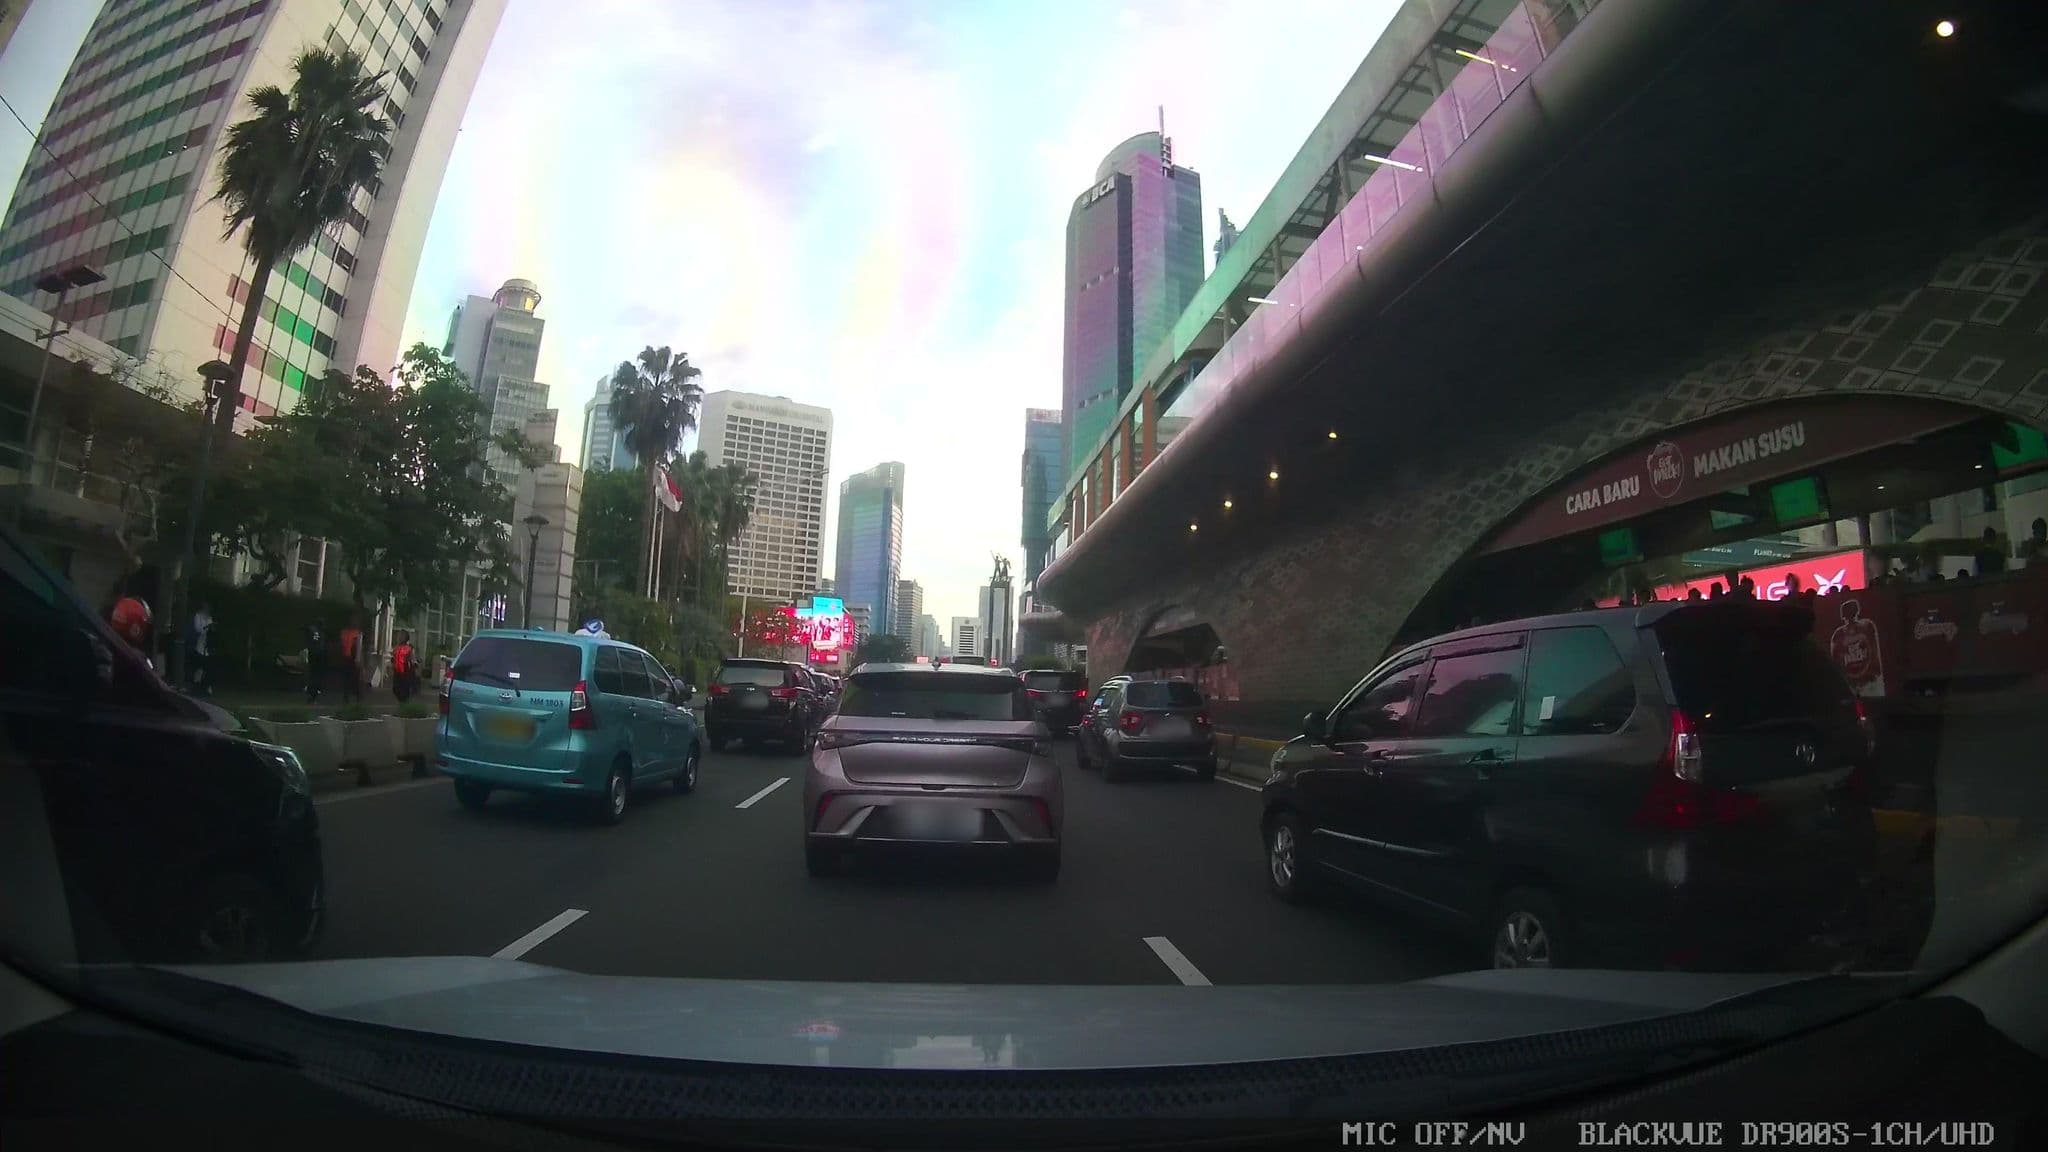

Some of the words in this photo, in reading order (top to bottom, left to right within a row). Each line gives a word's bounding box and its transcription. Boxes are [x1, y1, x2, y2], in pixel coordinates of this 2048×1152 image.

[1092, 175, 1115, 202] BCA
[1693, 437, 1757, 478] MAKAN
[1757, 421, 1807, 458] SUSU
[1565, 488, 1602, 515] CARA
[1603, 475, 1641, 505] BARU
